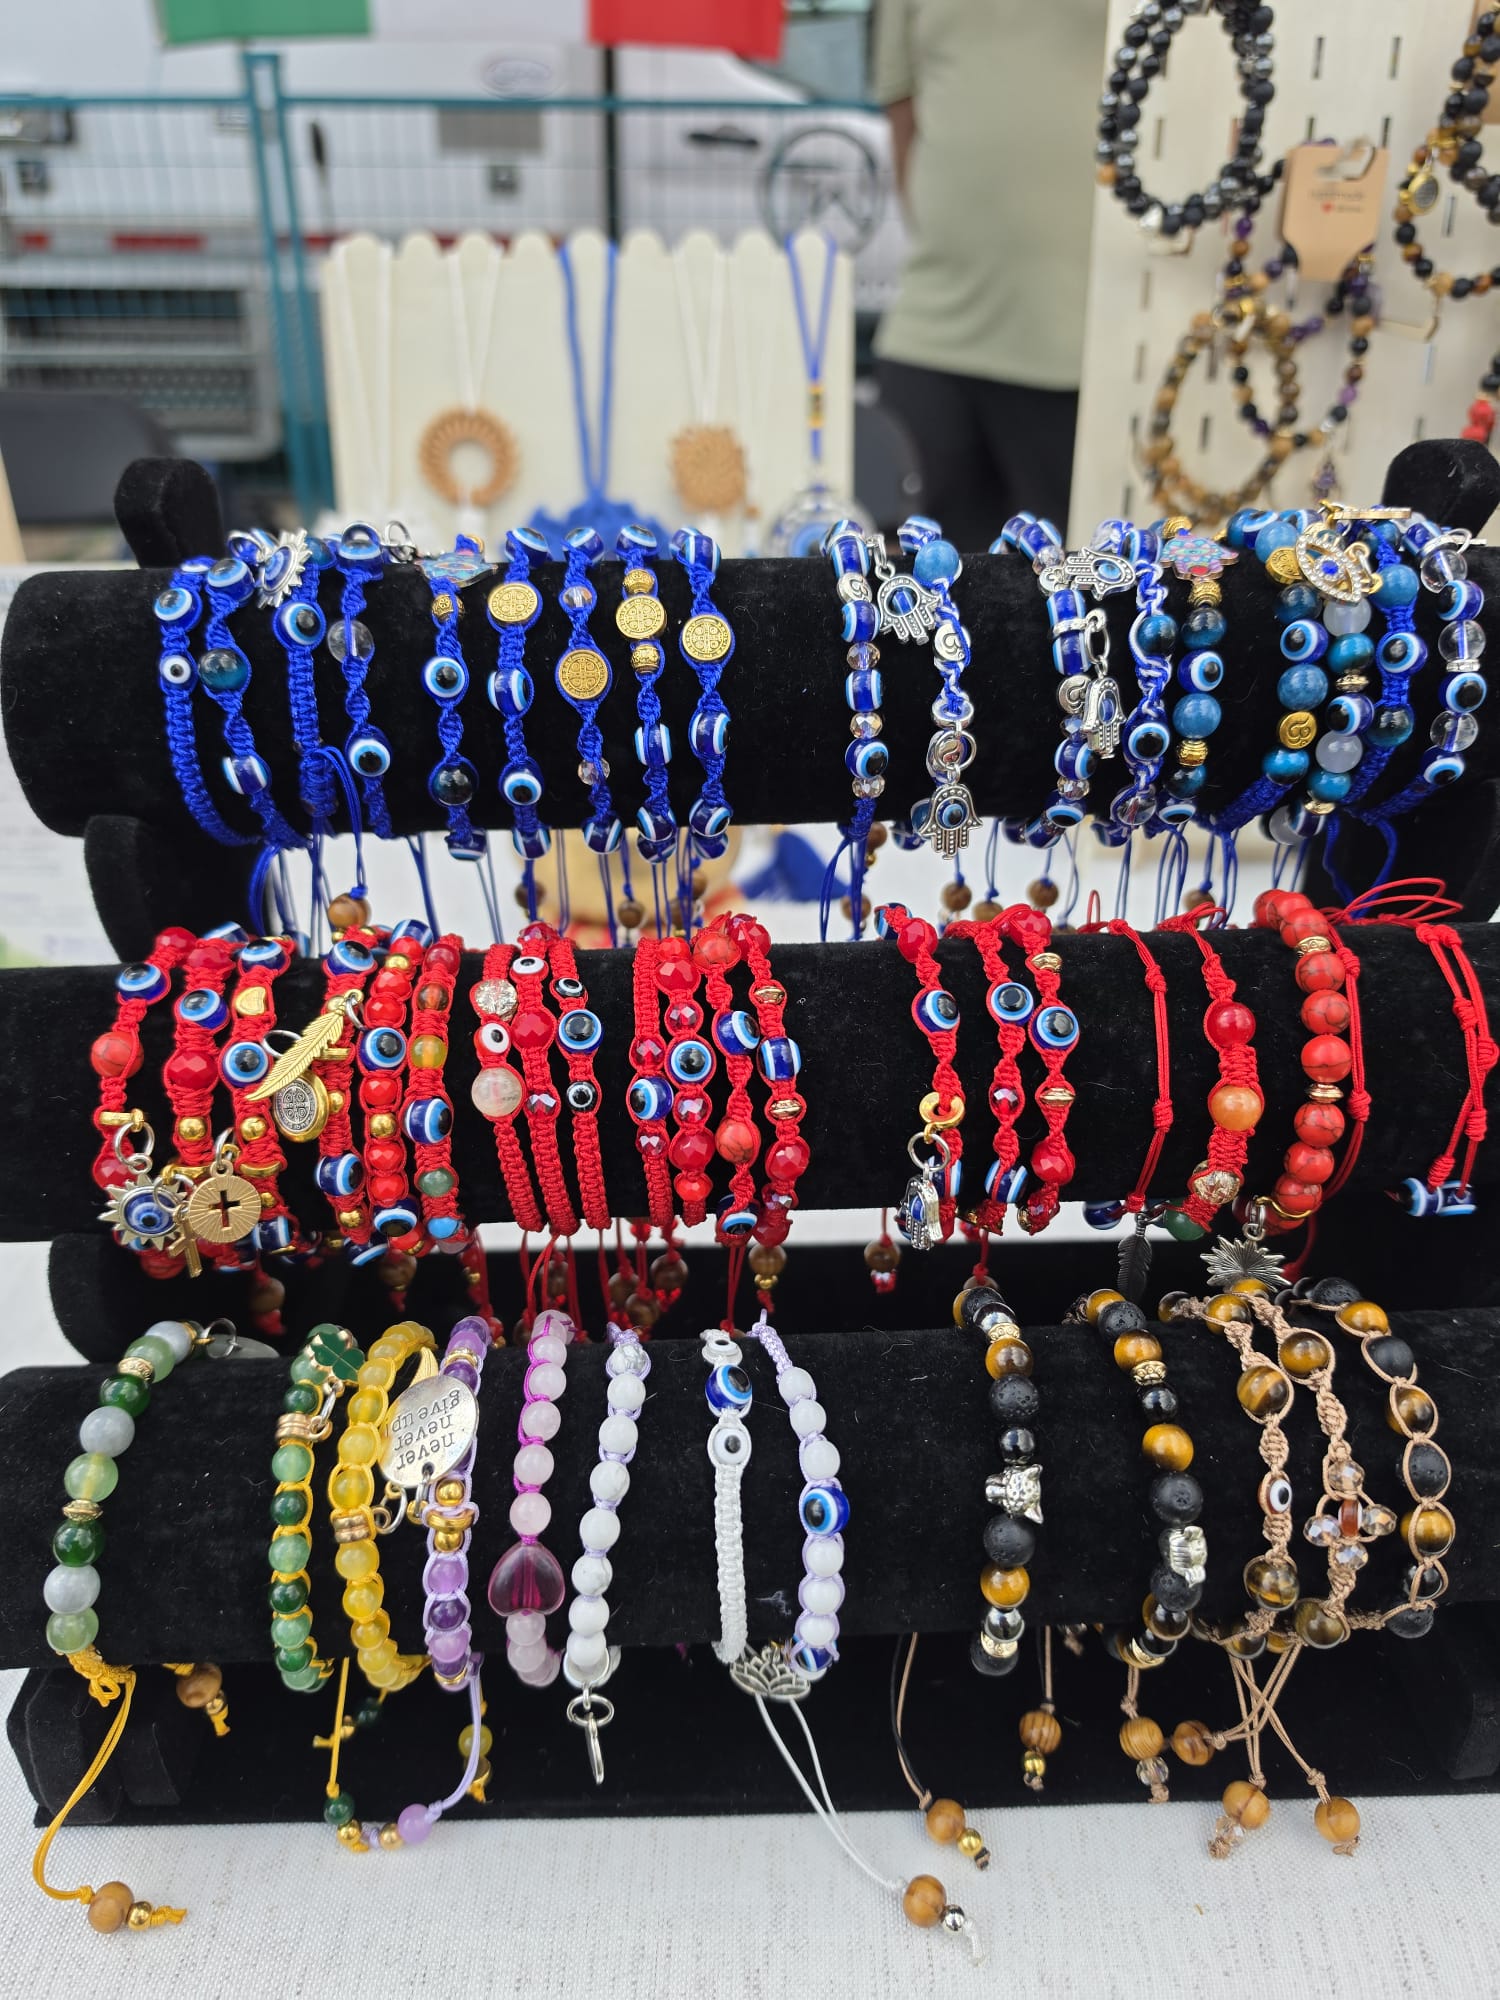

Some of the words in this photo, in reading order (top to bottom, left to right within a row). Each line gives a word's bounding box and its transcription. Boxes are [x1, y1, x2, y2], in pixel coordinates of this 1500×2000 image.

[418, 1389, 460, 1420] give
[394, 1414, 453, 1451] never
[396, 1432, 455, 1470] never
